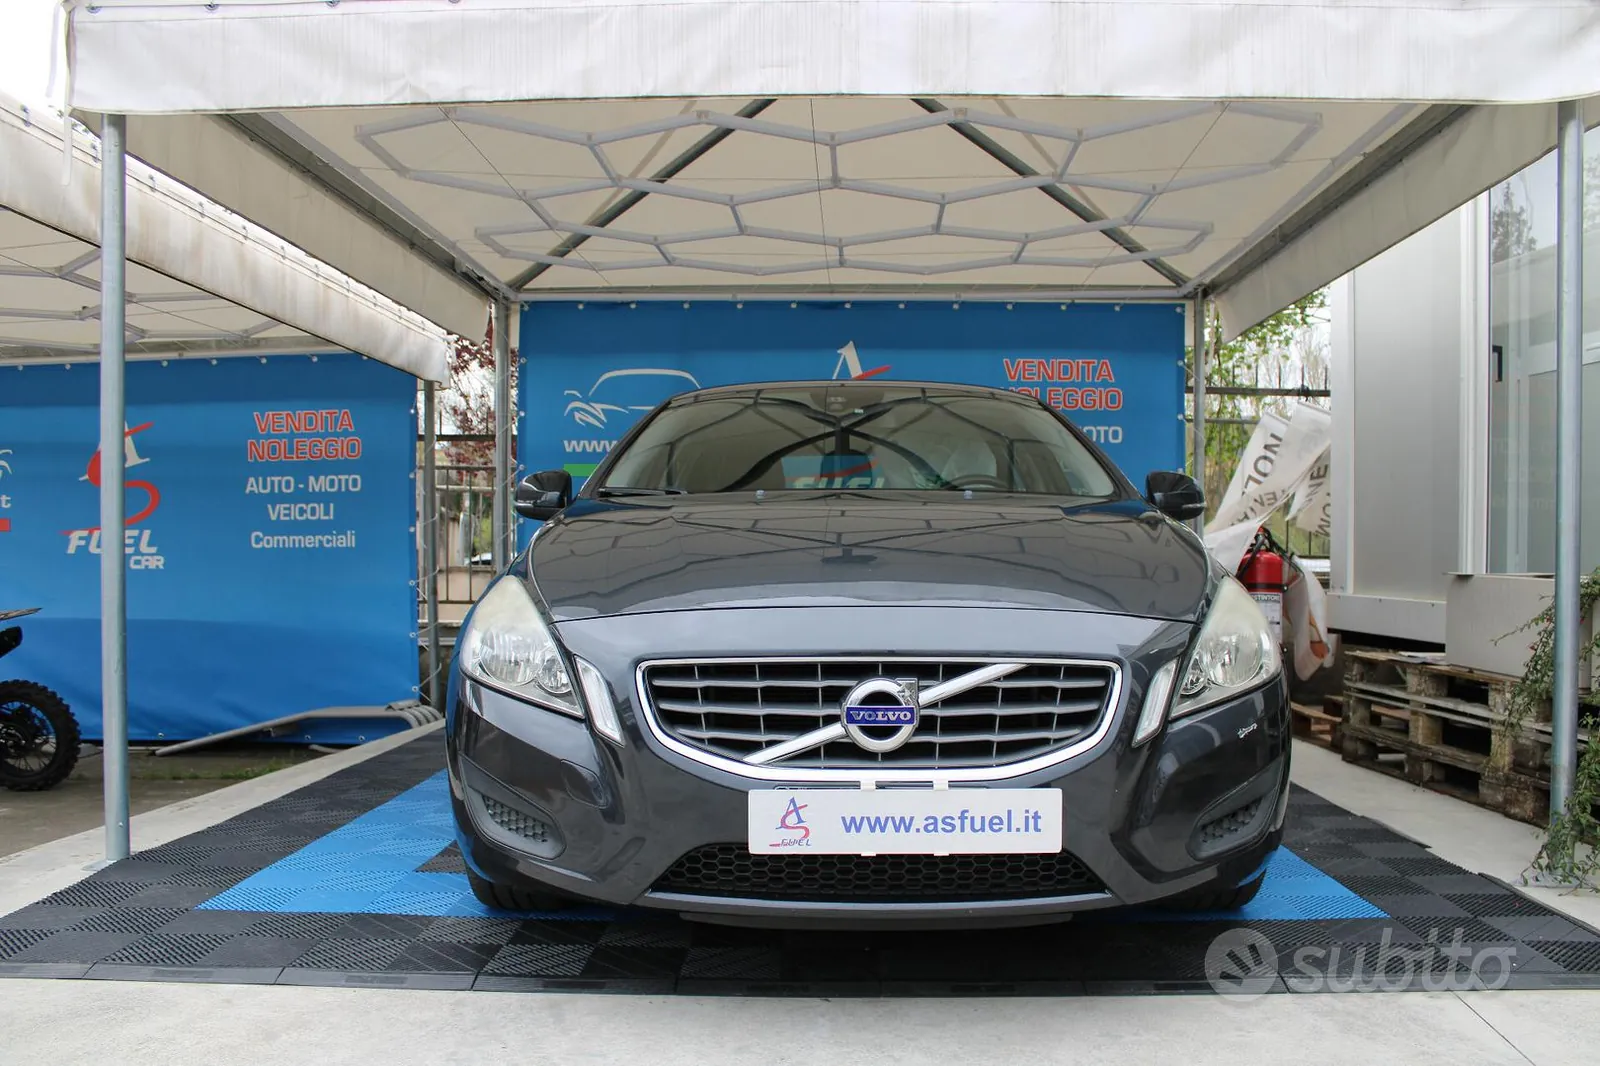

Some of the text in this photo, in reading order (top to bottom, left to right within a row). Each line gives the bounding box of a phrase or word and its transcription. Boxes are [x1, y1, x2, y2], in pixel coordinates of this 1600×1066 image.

[1003, 358, 1115, 382] VENDITA
[1000, 387, 1123, 411] EGGIO
[253, 409, 355, 434] VENDITA
[1080, 426, 1123, 443] OTO
[247, 437, 363, 462] NOLEGGIO
[245, 477, 295, 494] AUTO
[308, 475, 361, 493] MOTO
[267, 503, 334, 521] VEICOLI
[250, 531, 356, 549] Commerciali
[129, 555, 165, 570] CAR
[850, 710, 912, 722] VOLVO
[841, 809, 1042, 833] www.asfuel.it
